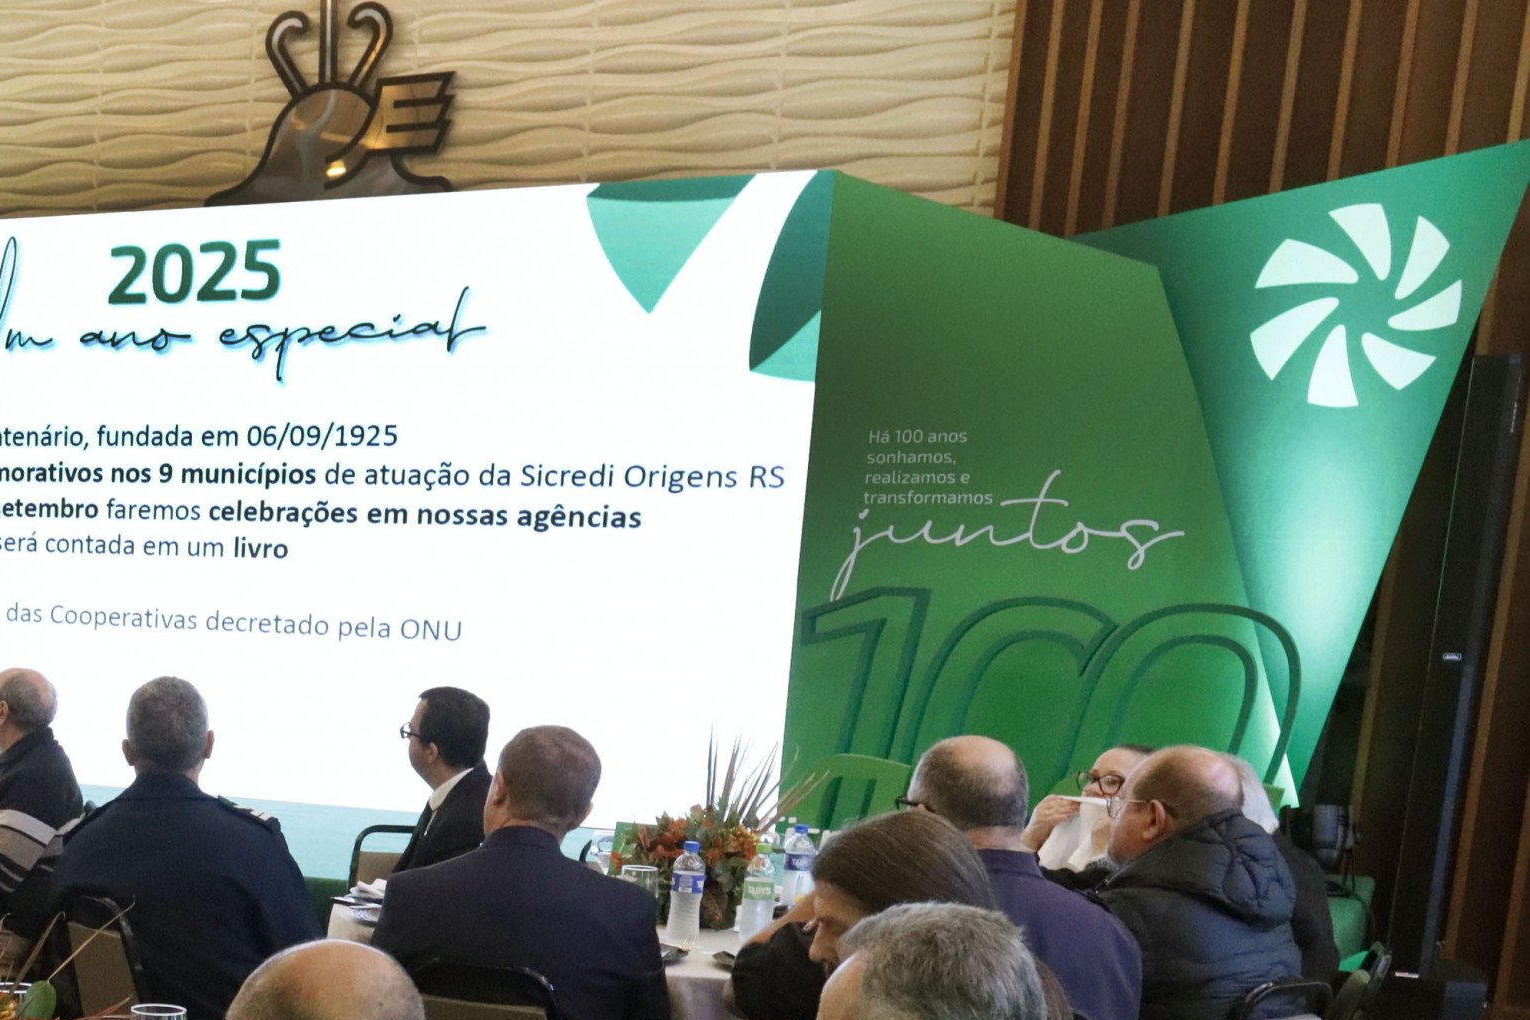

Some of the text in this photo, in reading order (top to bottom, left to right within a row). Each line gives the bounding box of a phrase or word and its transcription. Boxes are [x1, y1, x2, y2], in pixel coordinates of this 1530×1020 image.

[107, 239, 282, 305] 2025
[80, 327, 192, 353] ano
[219, 286, 487, 382] especial
[96, 423, 193, 447] fundada
[201, 429, 239, 448] em
[246, 421, 398, 451] 06/09/1925
[869, 429, 968, 444] Há 100 anos
[866, 450, 956, 465] sonhamos,
[110, 466, 152, 484] nos
[158, 462, 174, 484] 9
[181, 461, 317, 490] municípios
[324, 461, 356, 486] de
[364, 461, 470, 492] atuação
[478, 462, 511, 487] da
[520, 462, 614, 488] Sicredi
[624, 464, 738, 495] Origens
[749, 465, 785, 489] RS
[864, 470, 970, 484] realizamos e
[863, 490, 994, 505] transformamos
[106, 497, 201, 521] faremos
[208, 499, 358, 529] celebrações
[366, 507, 408, 525] em
[417, 507, 508, 527] nossas
[516, 503, 642, 533] agências
[45, 533, 135, 556] contada
[143, 539, 179, 557] em
[187, 540, 224, 558] um
[234, 535, 289, 560] livro
[829, 469, 1186, 602] juntos
[5, 602, 43, 623] das
[49, 605, 198, 631] Cooperativas
[205, 610, 330, 636] decretado
[337, 616, 392, 642] pela
[399, 619, 463, 642] ONU
